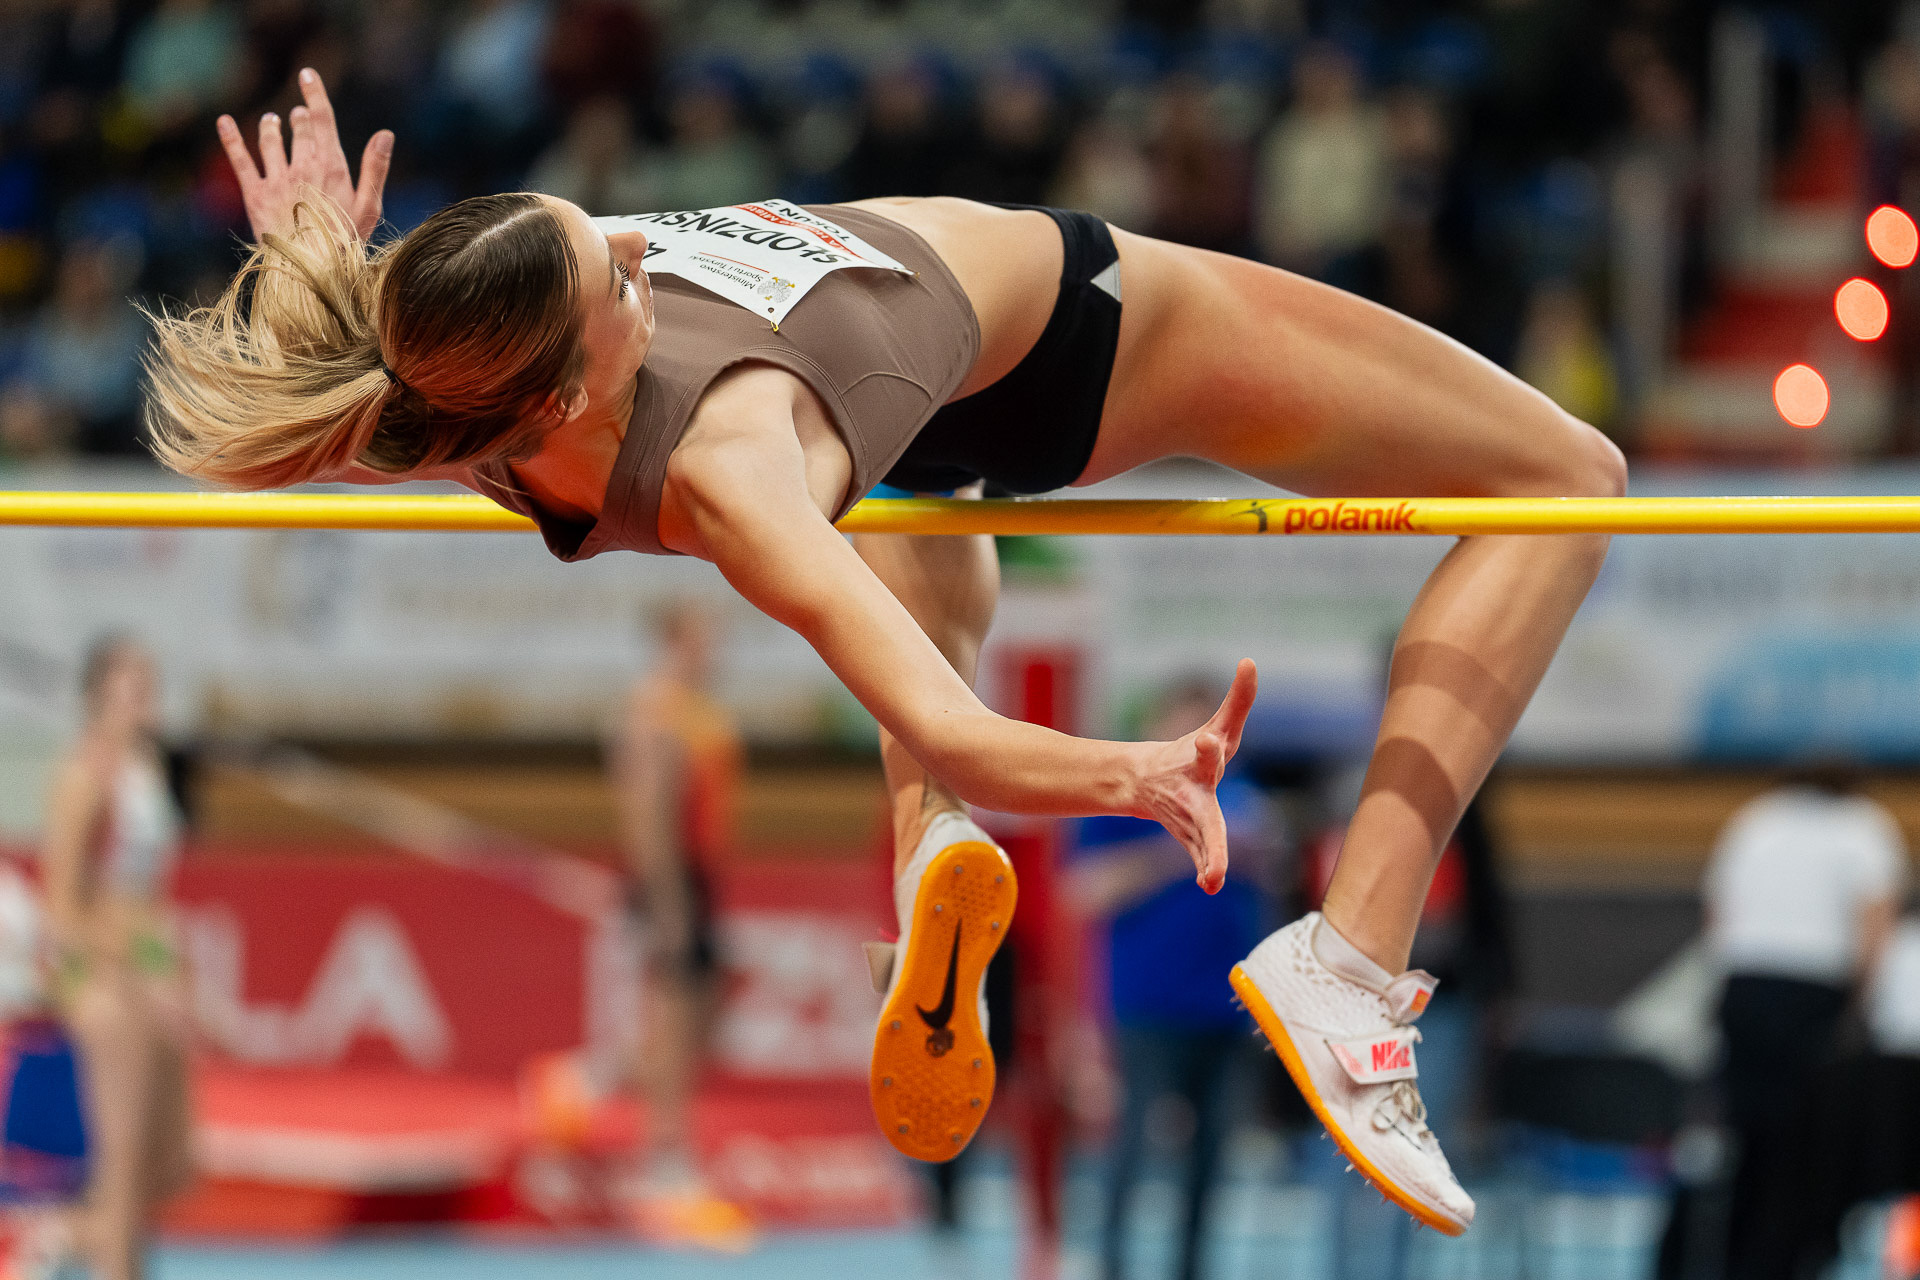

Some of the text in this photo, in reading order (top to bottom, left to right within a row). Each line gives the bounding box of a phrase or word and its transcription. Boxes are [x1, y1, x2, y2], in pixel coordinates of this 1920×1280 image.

[617, 211, 852, 263] SŁODZIŃSK
[688, 255, 728, 270] Turystyki
[734, 266, 764, 283] Sportu
[699, 264, 756, 290] Ministerstwo
[1284, 502, 1417, 535] polanik
